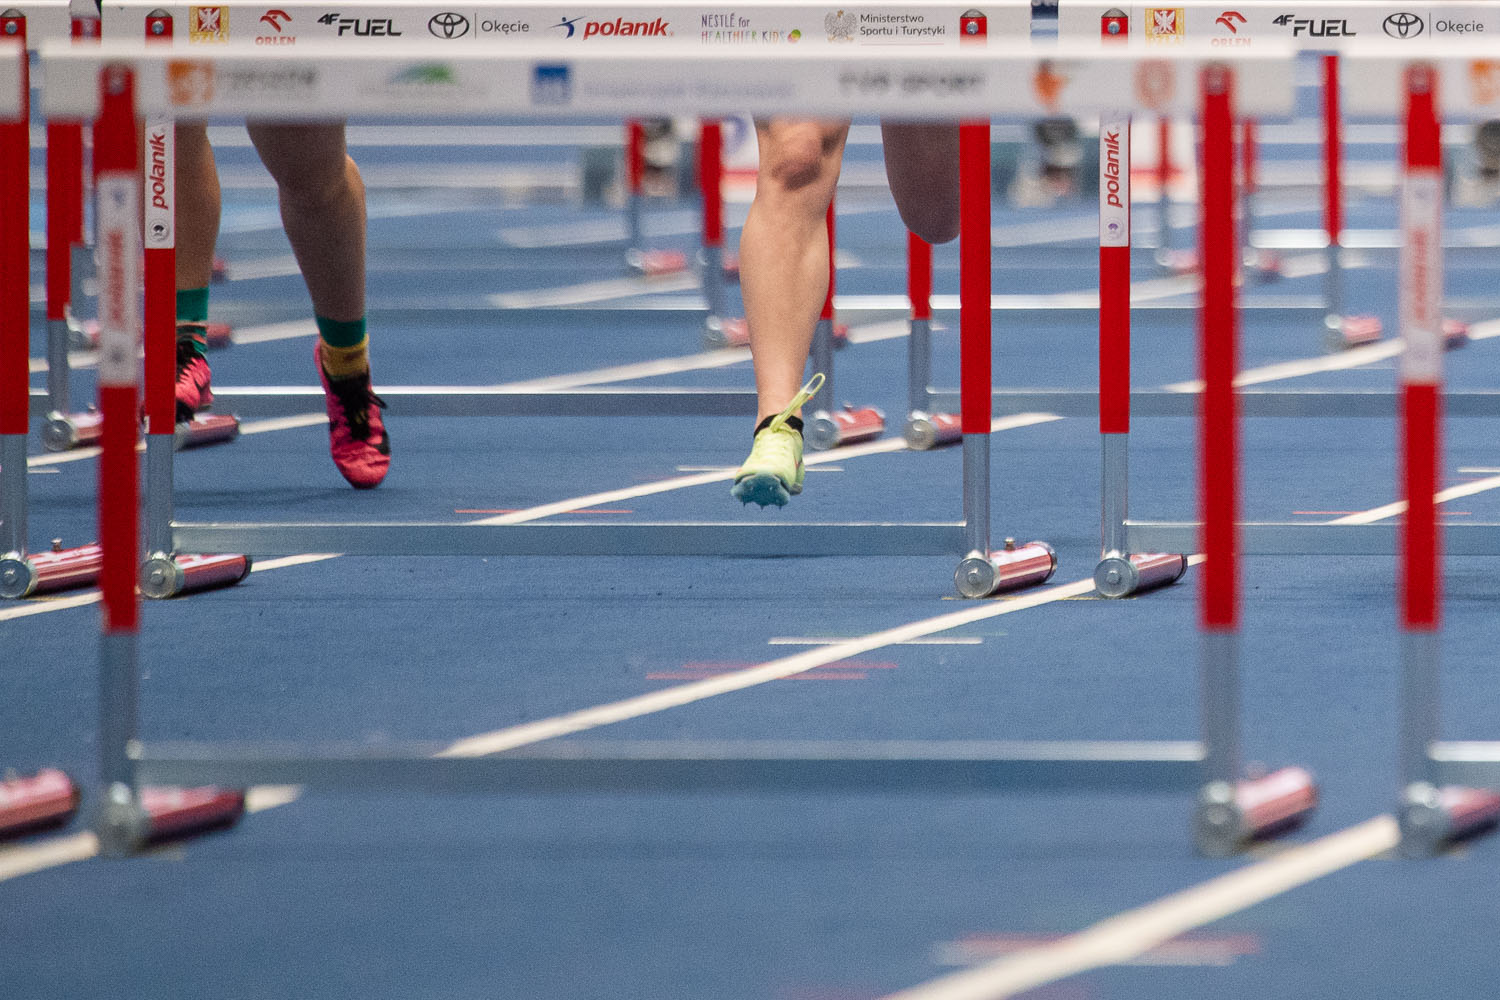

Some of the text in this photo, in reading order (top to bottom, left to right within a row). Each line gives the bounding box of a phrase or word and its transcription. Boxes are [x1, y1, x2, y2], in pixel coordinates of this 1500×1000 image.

[701, 13, 751, 28] NESTLÉ for
[859, 14, 925, 23] Ministerstwo
[338, 19, 402, 37] FUEL
[481, 20, 530, 36] Okęcie
[582, 17, 671, 41] polanik
[859, 26, 946, 37] Sportu i Turystyki
[1292, 20, 1357, 37] FUEL
[1435, 20, 1485, 35] Okęcie
[255, 36, 296, 46] ORLEN
[152, 132, 169, 210] polanik
[1103, 131, 1123, 209] polanik
